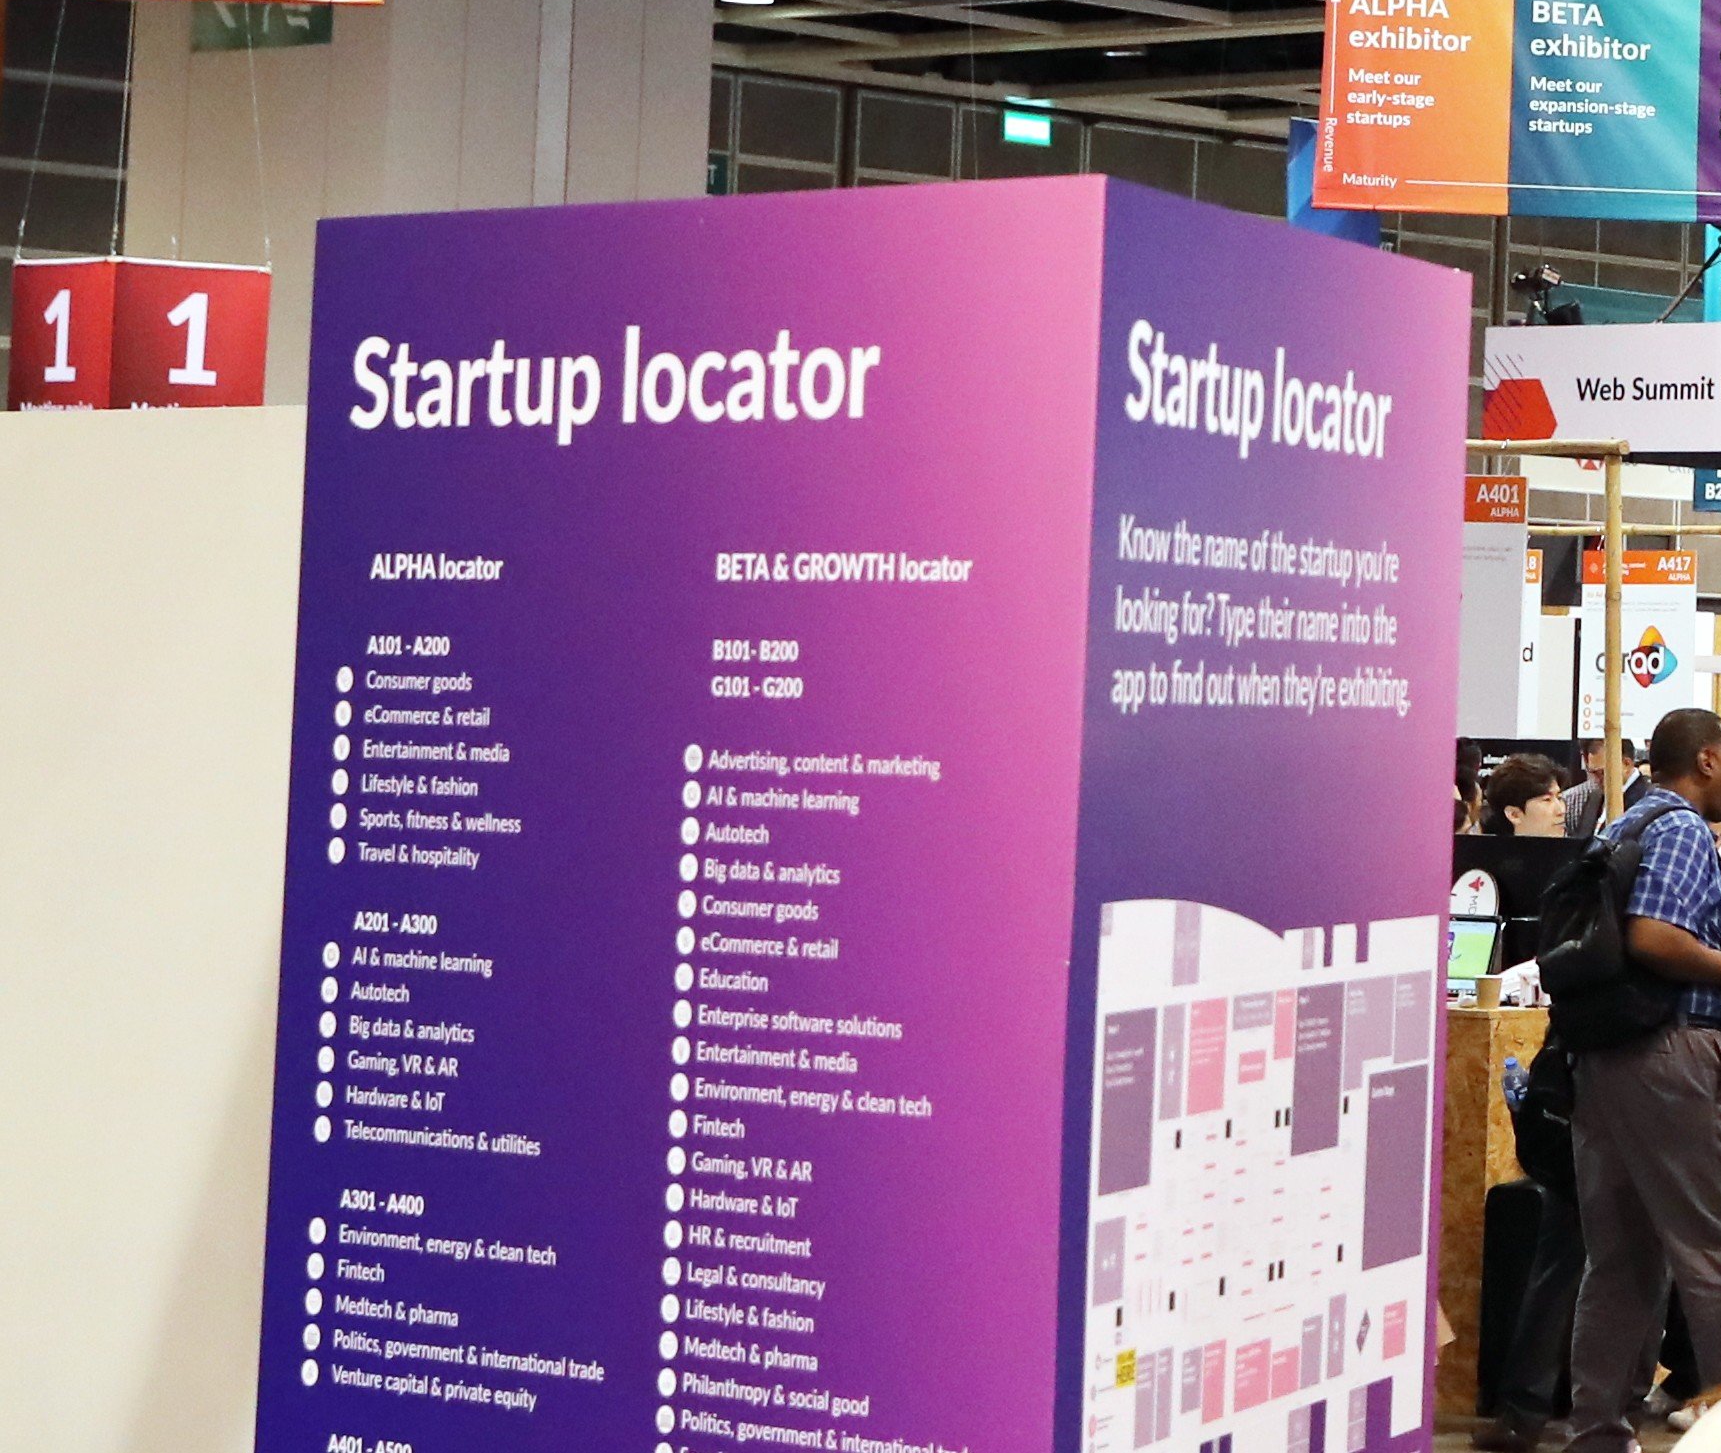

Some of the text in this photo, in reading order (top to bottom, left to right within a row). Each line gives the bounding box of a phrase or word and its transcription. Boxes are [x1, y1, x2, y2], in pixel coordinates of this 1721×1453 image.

[1532, 0, 1603, 26] BETA
[1349, 25, 1471, 51] exhibitor
[1530, 32, 1651, 61] exhibitor
[1348, 68, 1421, 85] Meet our
[1530, 76, 1602, 93] Meet our
[1347, 89, 1434, 109] early-stage
[1529, 98, 1656, 119] expansion-stage
[1346, 110, 1411, 128] startups
[1528, 118, 1592, 136] startups
[1324, 116, 1336, 173] Revenue
[1342, 172, 1397, 188] Maturity
[44, 289, 76, 382] 1
[167, 292, 216, 385] 1
[349, 325, 881, 446] Startup locator
[1125, 319, 1392, 459] Startup locator
[1576, 376, 1625, 401] Web
[1632, 375, 1714, 401] Summit
[1476, 483, 1519, 503] A401
[1490, 507, 1519, 517] ALPHA
[1119, 514, 1400, 586] Know the name of the startup you're
[370, 552, 503, 580] ALPHA locator
[716, 552, 973, 582] BETA & GROWTH locator
[1657, 556, 1691, 571] A417
[366, 635, 402, 655] A101
[412, 635, 450, 656] A200
[365, 669, 472, 694] Consumer goods
[350, 980, 409, 1002] Autotech
[698, 968, 768, 992] Education
[336, 1258, 384, 1282] Fintech
